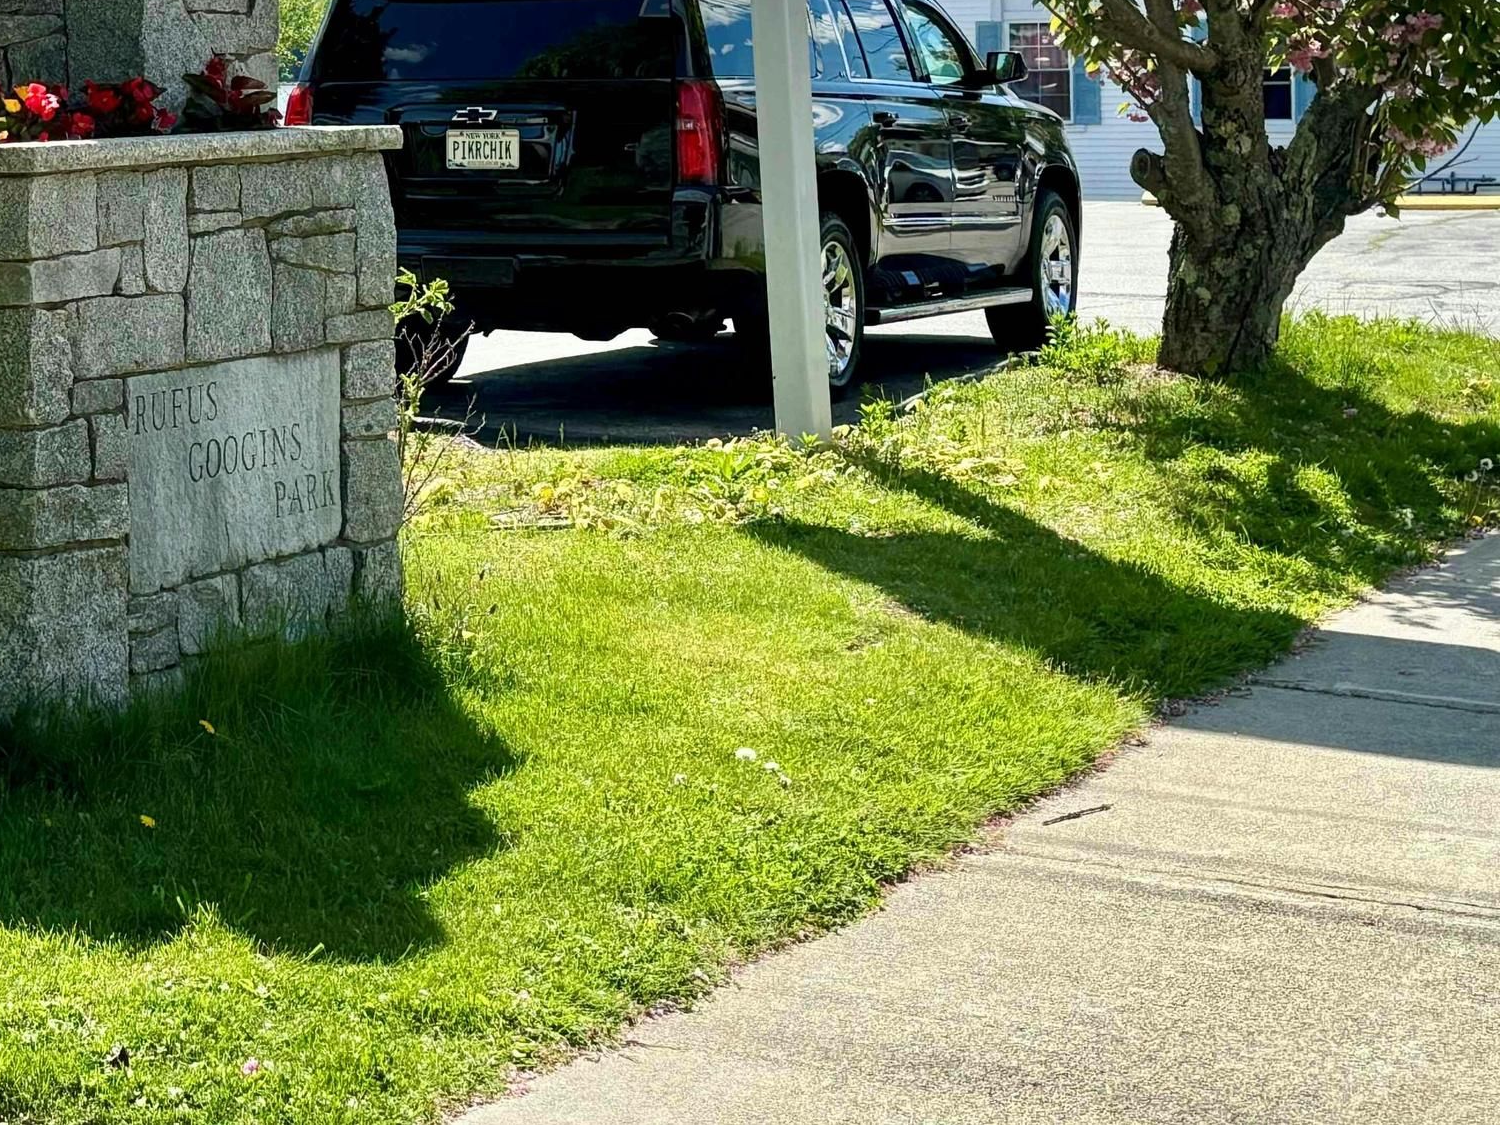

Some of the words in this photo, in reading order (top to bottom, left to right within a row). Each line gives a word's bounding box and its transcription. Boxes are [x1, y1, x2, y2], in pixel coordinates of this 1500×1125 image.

[452, 140, 512, 160] PIKRCHIK
[133, 381, 218, 435] RUFUS
[188, 423, 302, 483] GOOGINS
[274, 469, 336, 518] PARK
